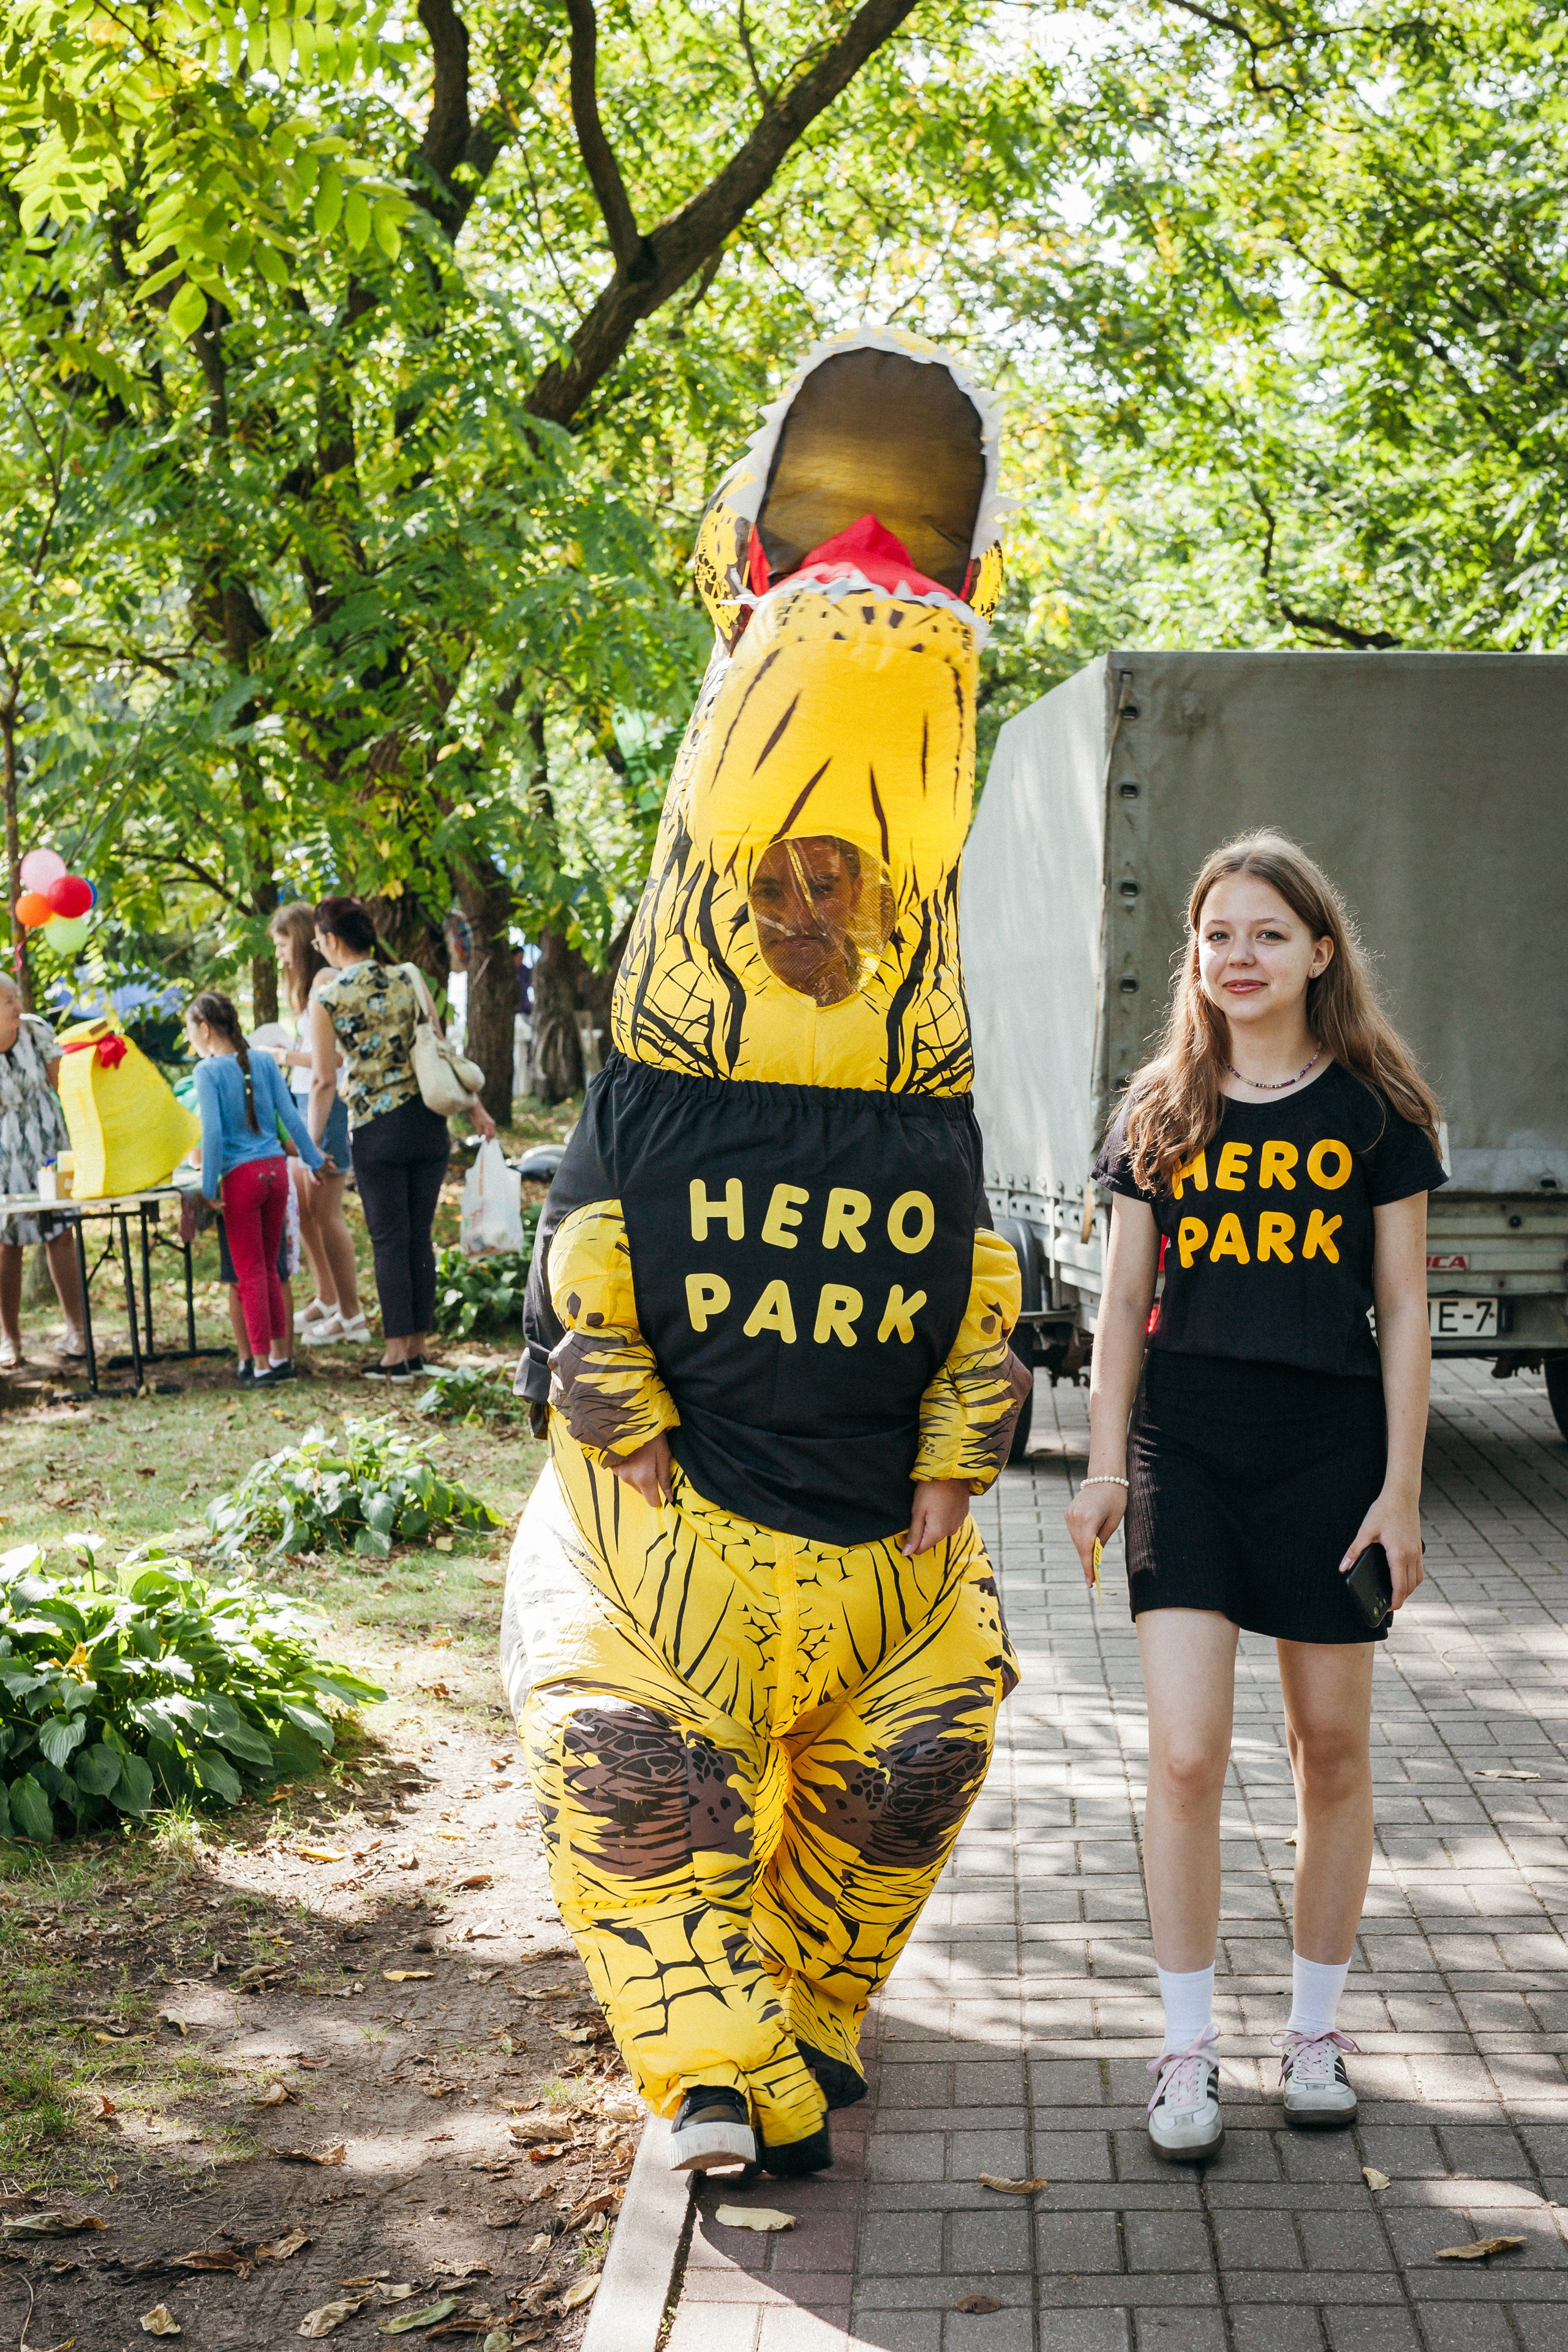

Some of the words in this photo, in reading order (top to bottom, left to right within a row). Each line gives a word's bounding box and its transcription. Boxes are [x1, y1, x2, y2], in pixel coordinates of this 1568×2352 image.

[689, 1177, 935, 1254] HERO
[1178, 1208, 1343, 1268] PARK
[685, 1273, 927, 1347] PARK
[1427, 1301, 1493, 1332] E-7
